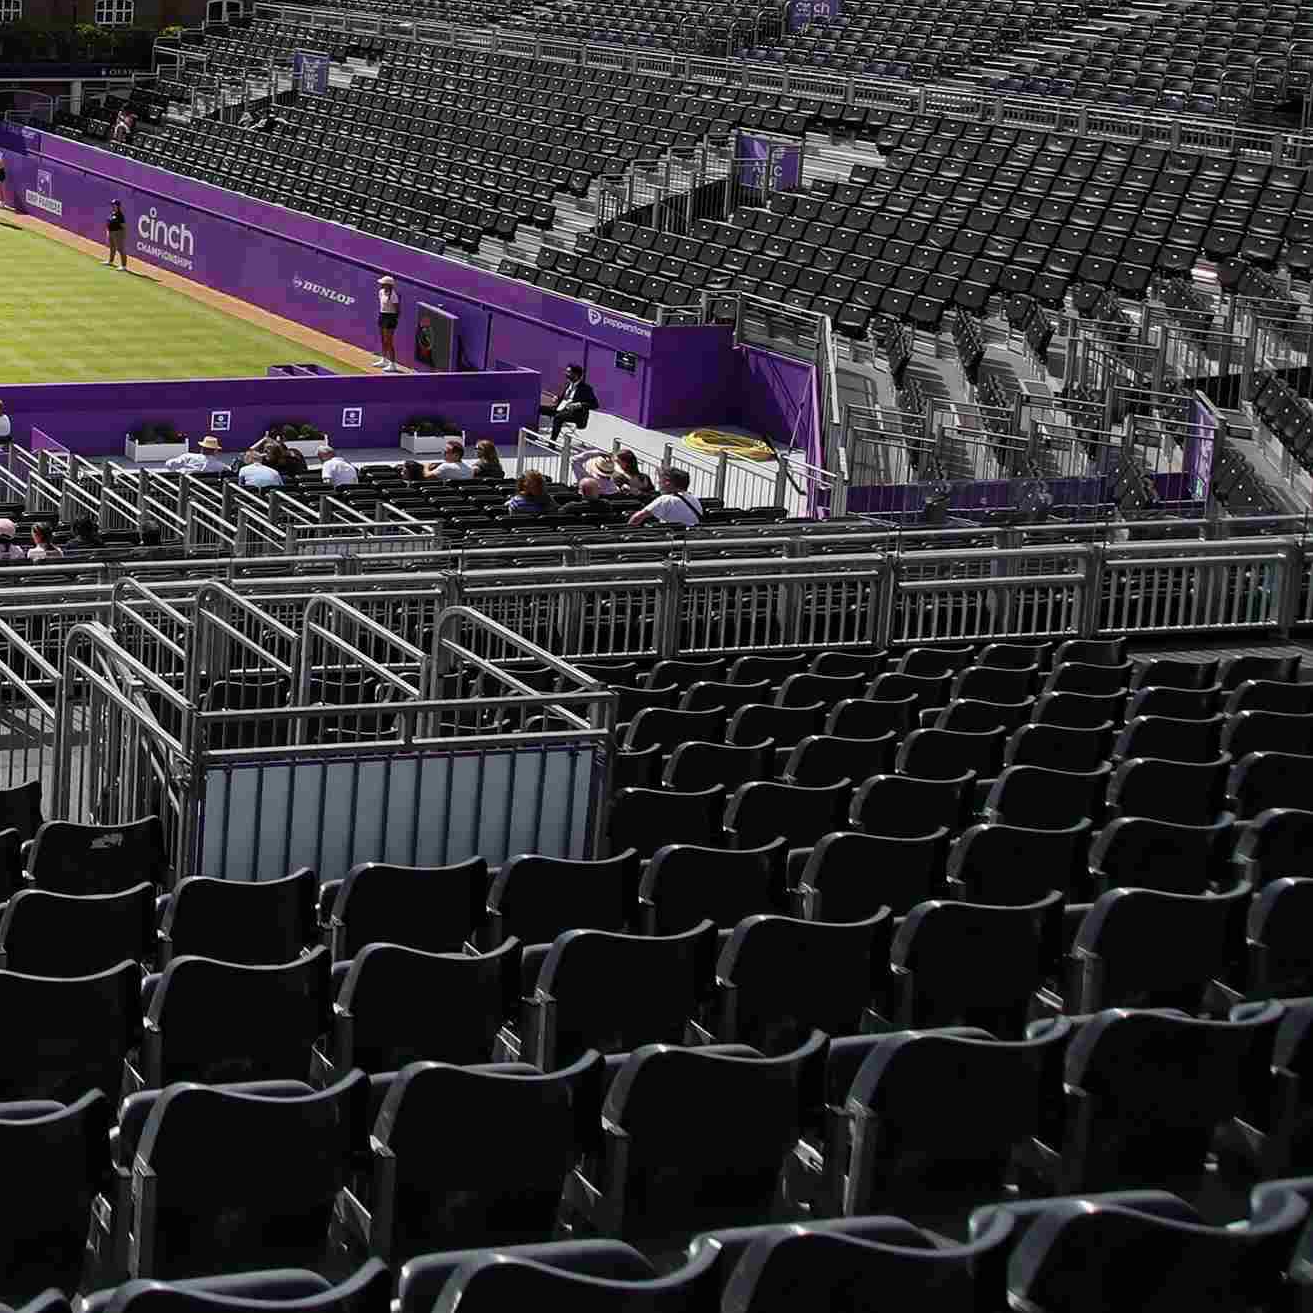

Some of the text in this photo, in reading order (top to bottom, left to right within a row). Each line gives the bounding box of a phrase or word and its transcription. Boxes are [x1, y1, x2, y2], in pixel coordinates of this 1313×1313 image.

[138, 207, 194, 256] cinch
[137, 241, 193, 270] CHAMPIONSHIPS
[302, 280, 356, 305] DUNLOP
